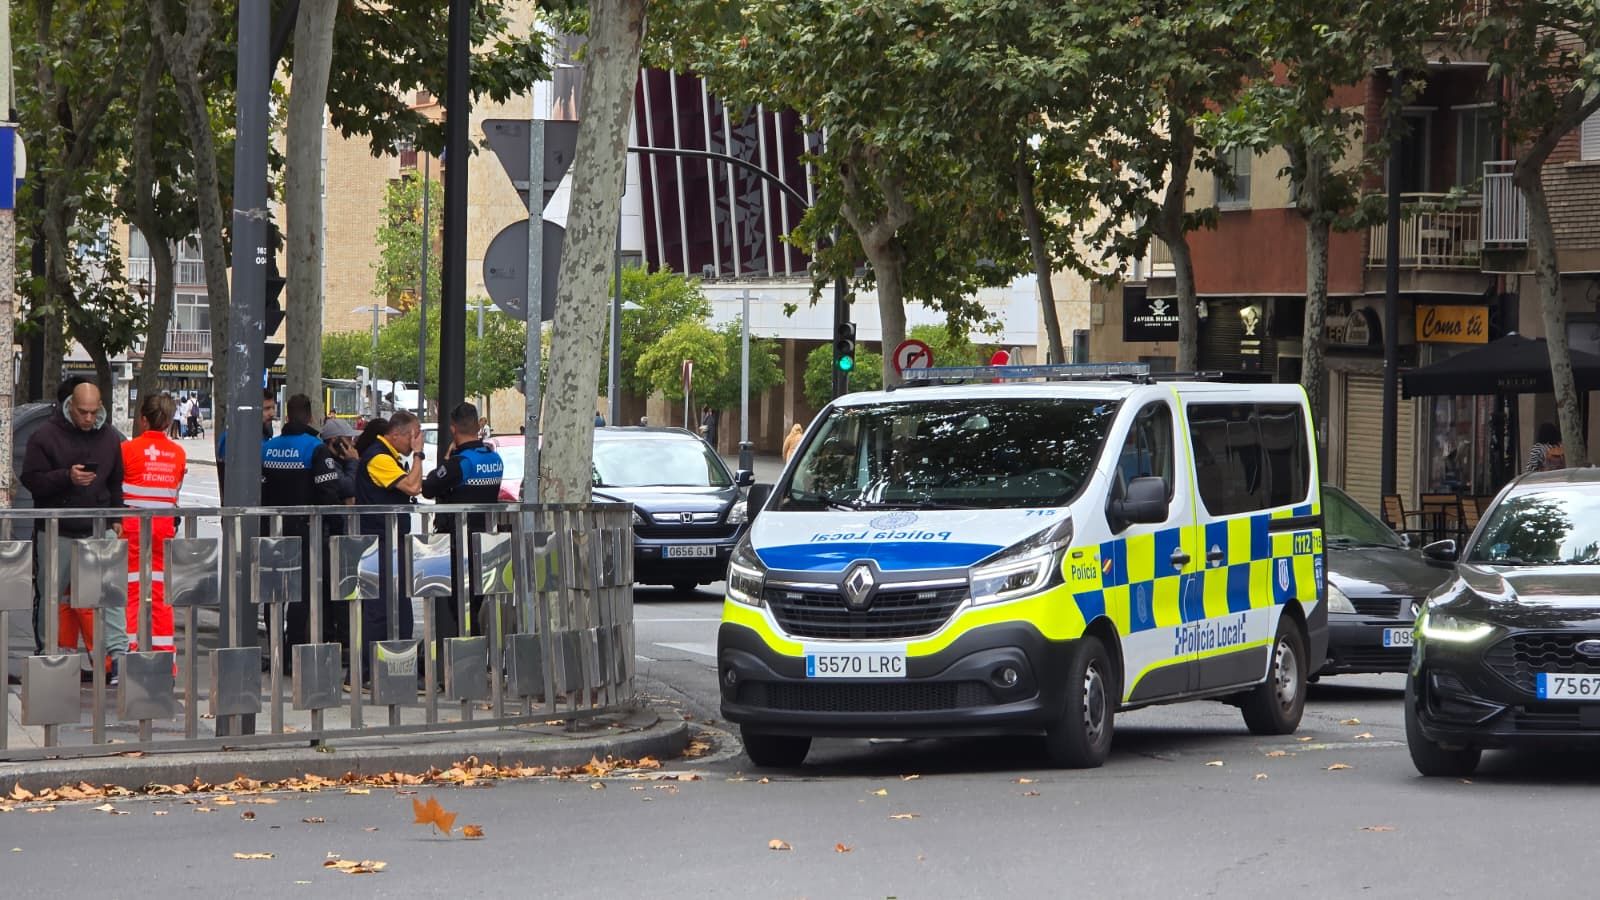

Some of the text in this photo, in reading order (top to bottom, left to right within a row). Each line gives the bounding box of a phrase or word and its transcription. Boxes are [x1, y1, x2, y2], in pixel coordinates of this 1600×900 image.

[1422, 308, 1483, 338] Como tú
[266, 448, 299, 458] POLICÍA
[476, 461, 503, 473] POLICÍA
[669, 547, 694, 556] 0656
[1182, 618, 1241, 654] Policía Local
[819, 656, 902, 673] 5570 LRC
[1554, 677, 1600, 695] 7567
